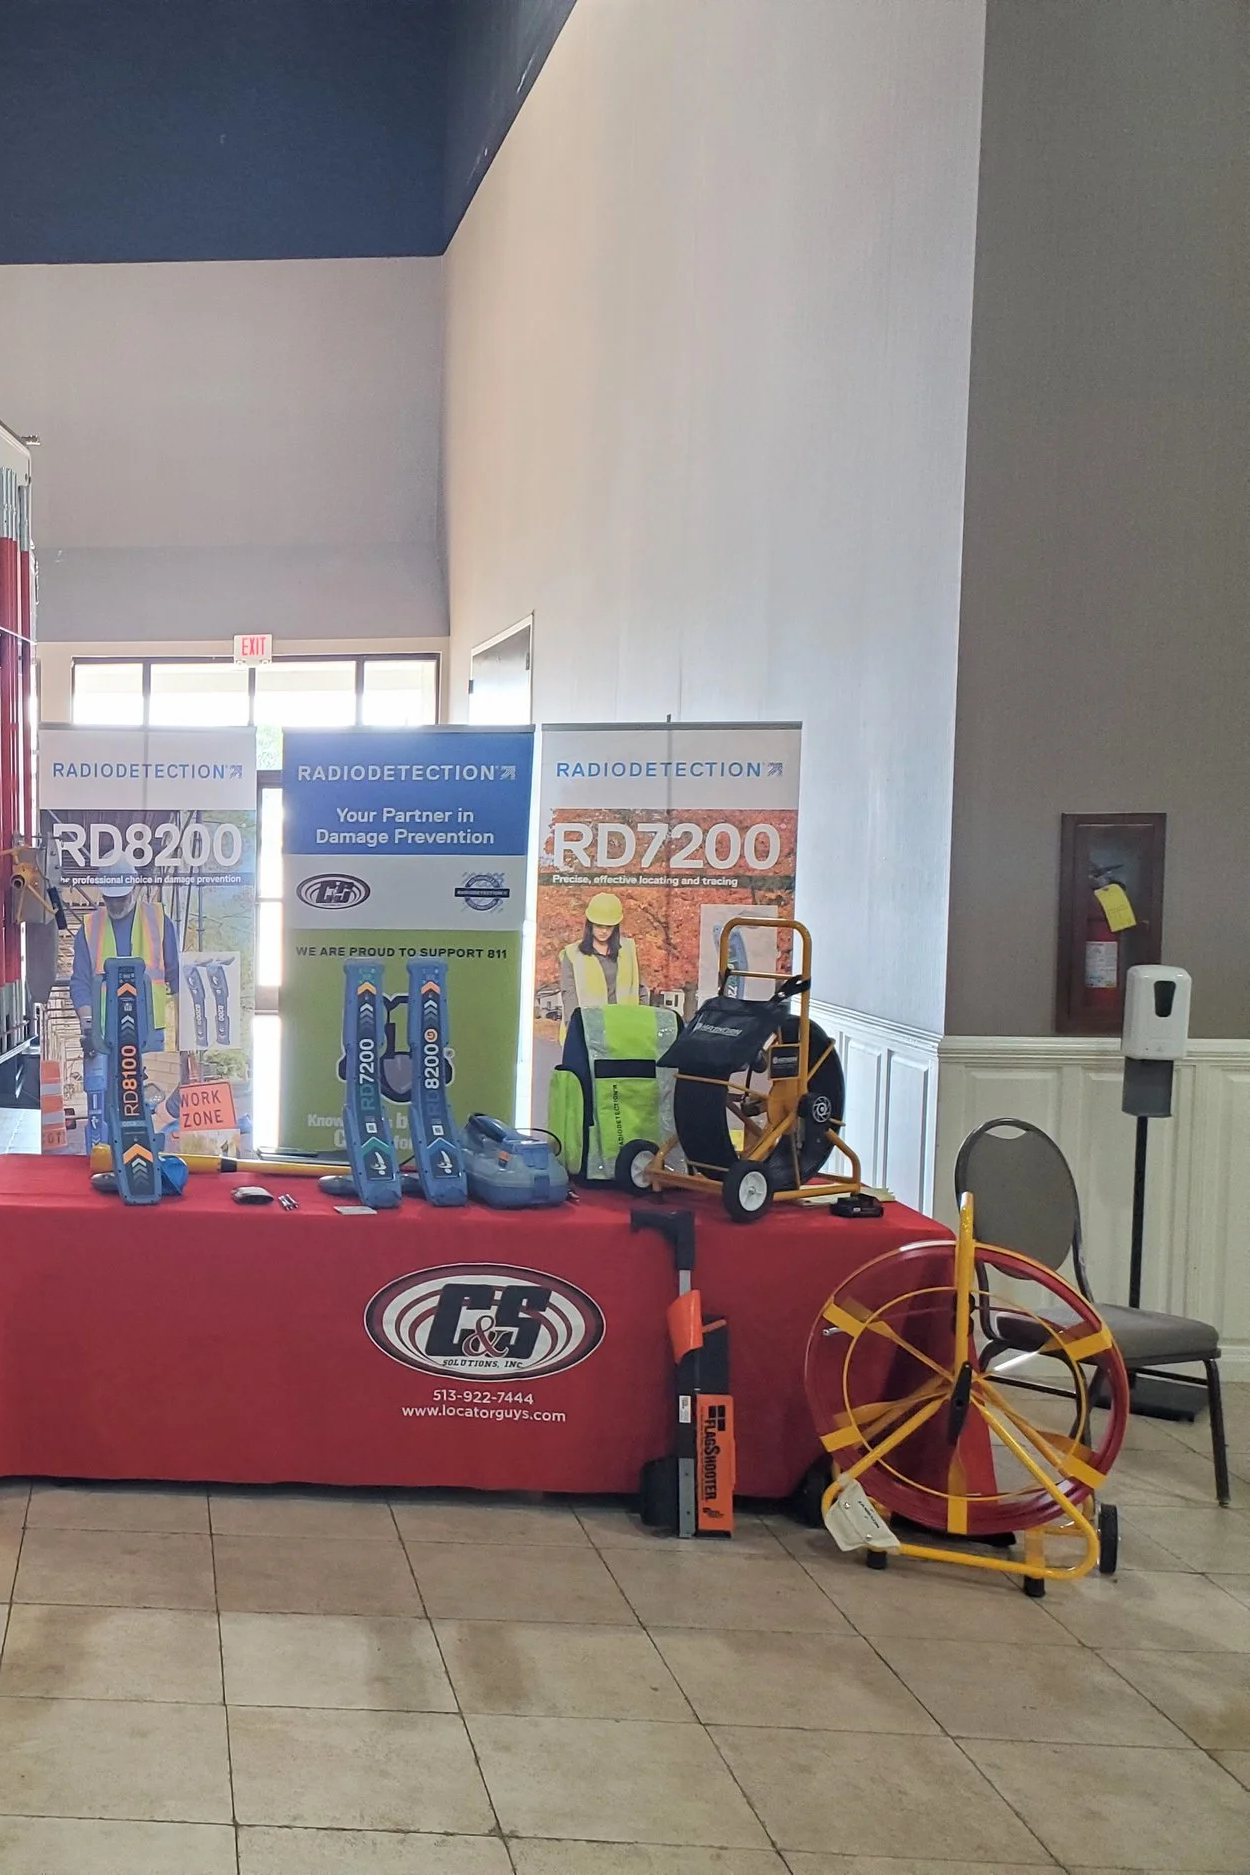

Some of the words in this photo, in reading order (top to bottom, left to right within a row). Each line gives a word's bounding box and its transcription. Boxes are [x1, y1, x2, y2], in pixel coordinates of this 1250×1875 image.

[242, 637, 266, 656] EXIT
[53, 763, 226, 779] RADIODETECTION
[298, 765, 495, 781] RADIODETECTION
[557, 762, 761, 777] RADIODETECTION
[336, 808, 377, 823] Your
[383, 808, 452, 823] Partner
[458, 808, 474, 822] in
[53, 823, 242, 867] RD8200
[316, 829, 389, 847] Damage
[394, 829, 494, 844] Prevention
[553, 823, 781, 870] RD7200
[72, 875, 123, 886] professional
[125, 874, 152, 884] choice
[154, 875, 163, 883] in
[164, 875, 195, 885] damage
[196, 875, 241, 885] prevention
[552, 875, 591, 884] Precise,
[594, 875, 637, 884] effective
[639, 876, 679, 886] locating
[681, 877, 699, 885] and
[702, 877, 738, 887] tracing
[296, 947, 317, 956] WE
[320, 947, 345, 956] ARE
[350, 947, 395, 957] PROUD
[399, 948, 416, 957] TO
[420, 948, 483, 958] SUPPORT
[487, 949, 507, 959] 811
[121, 1045, 140, 1116] RD8100
[180, 1090, 221, 1108] WORK
[182, 1110, 224, 1128] ZONE
[442, 1358, 500, 1368] SOLUTIONS,
[433, 1389, 534, 1405] 513-922-7444
[402, 1404, 566, 1422] www.locatorguys.com
